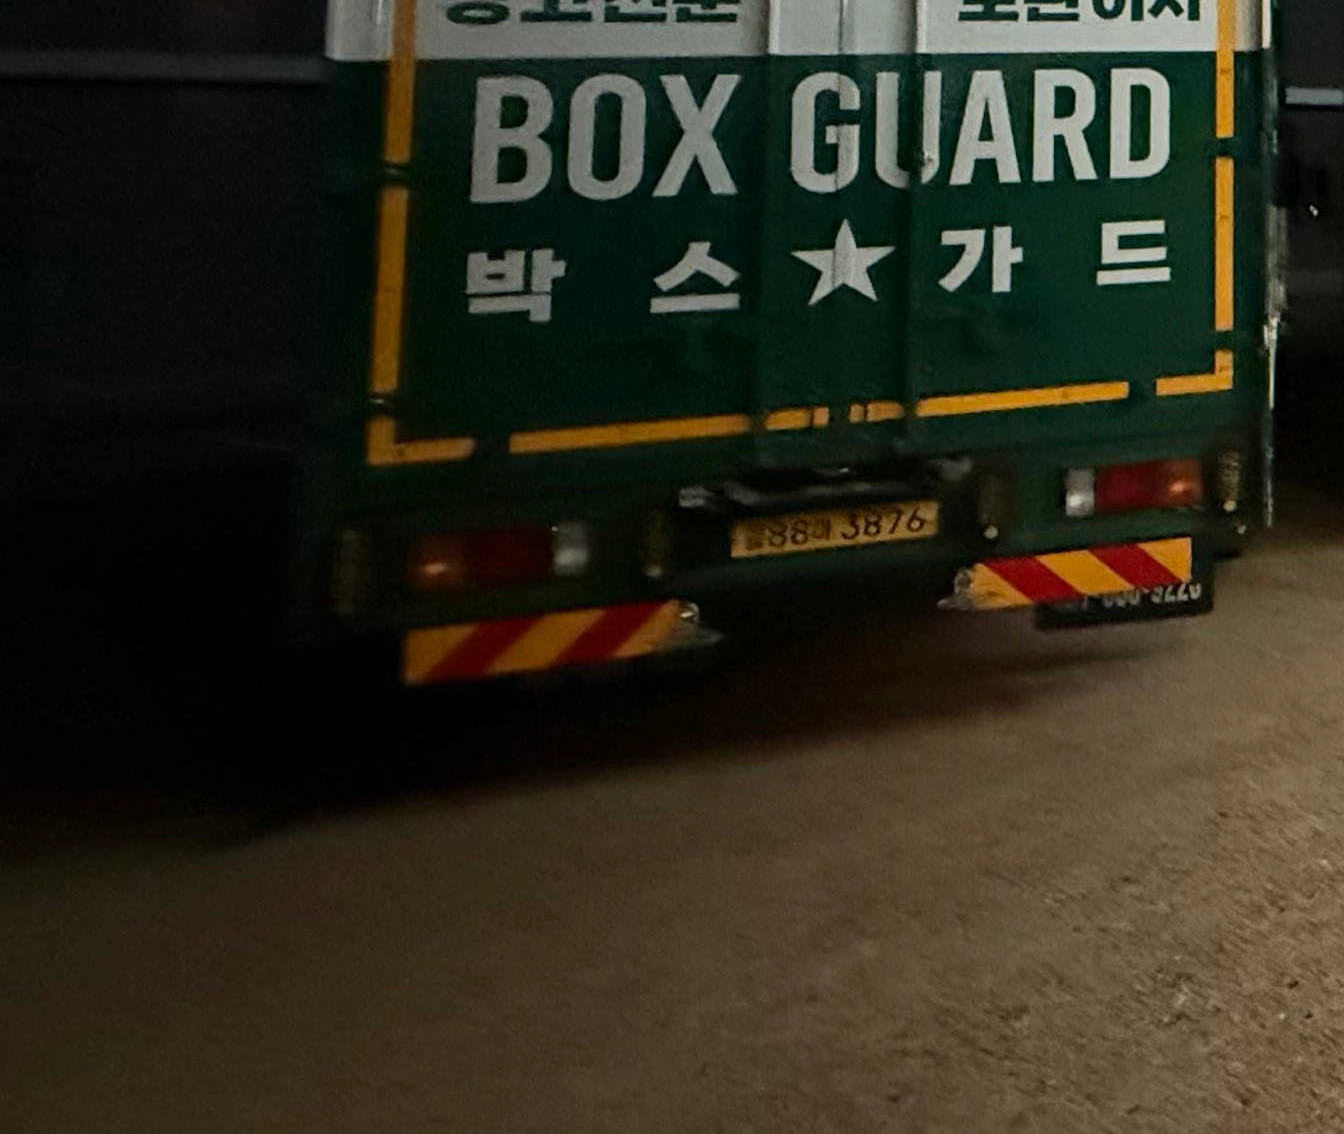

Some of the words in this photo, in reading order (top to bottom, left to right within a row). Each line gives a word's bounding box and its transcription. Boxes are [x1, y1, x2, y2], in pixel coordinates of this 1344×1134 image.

[468, 73, 744, 205] BOX
[790, 67, 1172, 194] GUARD
[840, 506, 926, 541] 3876
